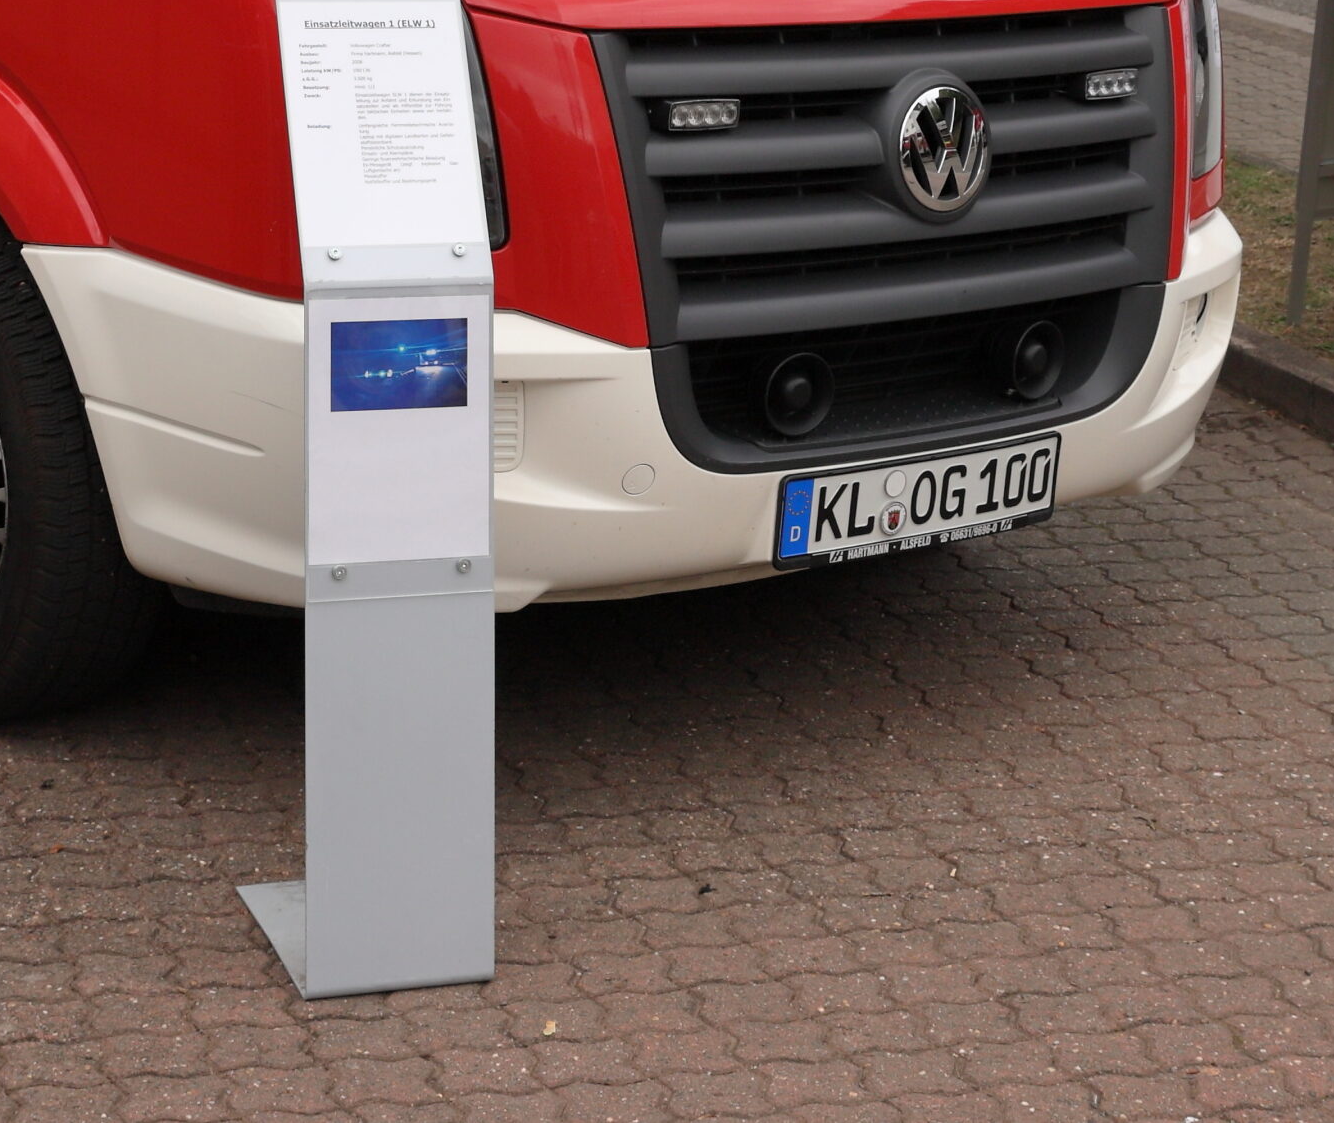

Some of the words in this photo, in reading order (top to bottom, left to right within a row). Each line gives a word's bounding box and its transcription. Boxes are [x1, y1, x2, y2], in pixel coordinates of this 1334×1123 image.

[304, 19, 386, 29] Einsatzleitwagen
[389, 20, 394, 28] 1
[397, 19, 423, 29] (ELW
[425, 19, 435, 29] 1)
[815, 482, 875, 542] KL
[910, 464, 968, 525] OG
[976, 448, 1050, 515] 100
[790, 526, 801, 541] D
[847, 542, 889, 560] HARTMANN
[900, 534, 932, 551] ALSFELD
